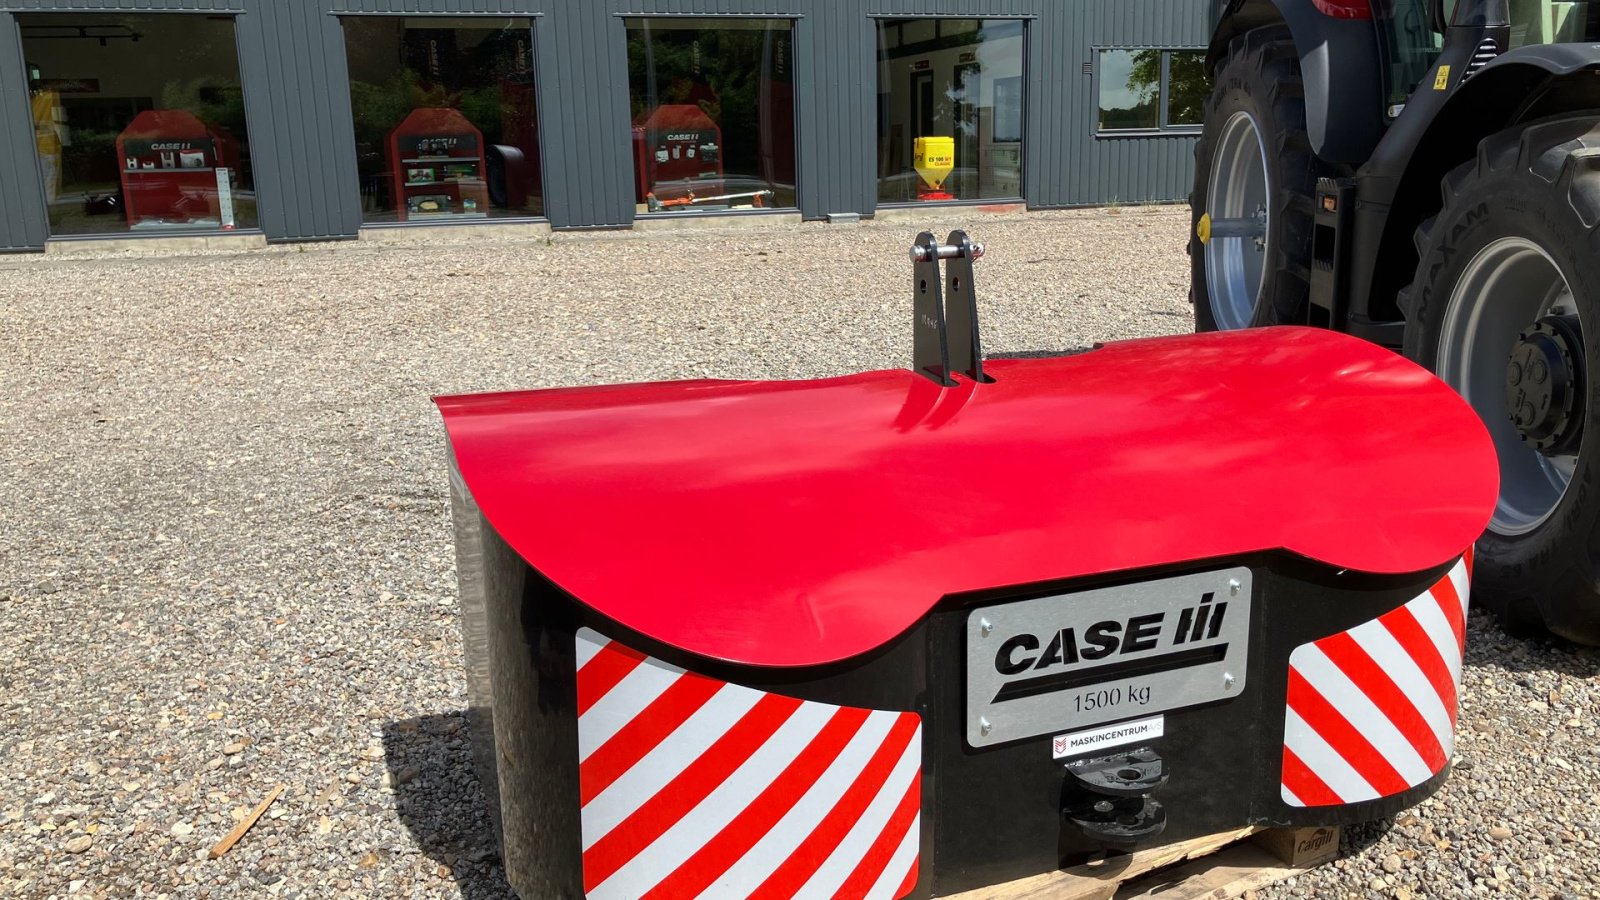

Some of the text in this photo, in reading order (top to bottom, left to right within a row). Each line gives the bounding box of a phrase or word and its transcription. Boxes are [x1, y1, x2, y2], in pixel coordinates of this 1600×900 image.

[151, 143, 180, 151] CASE
[1417, 202, 1489, 323] MAXAM
[994, 612, 1166, 675] CASE
[1073, 685, 1151, 713] 1500 kg
[1070, 725, 1148, 748] MASKINCENTRUM
[1297, 829, 1334, 854] Cargill
